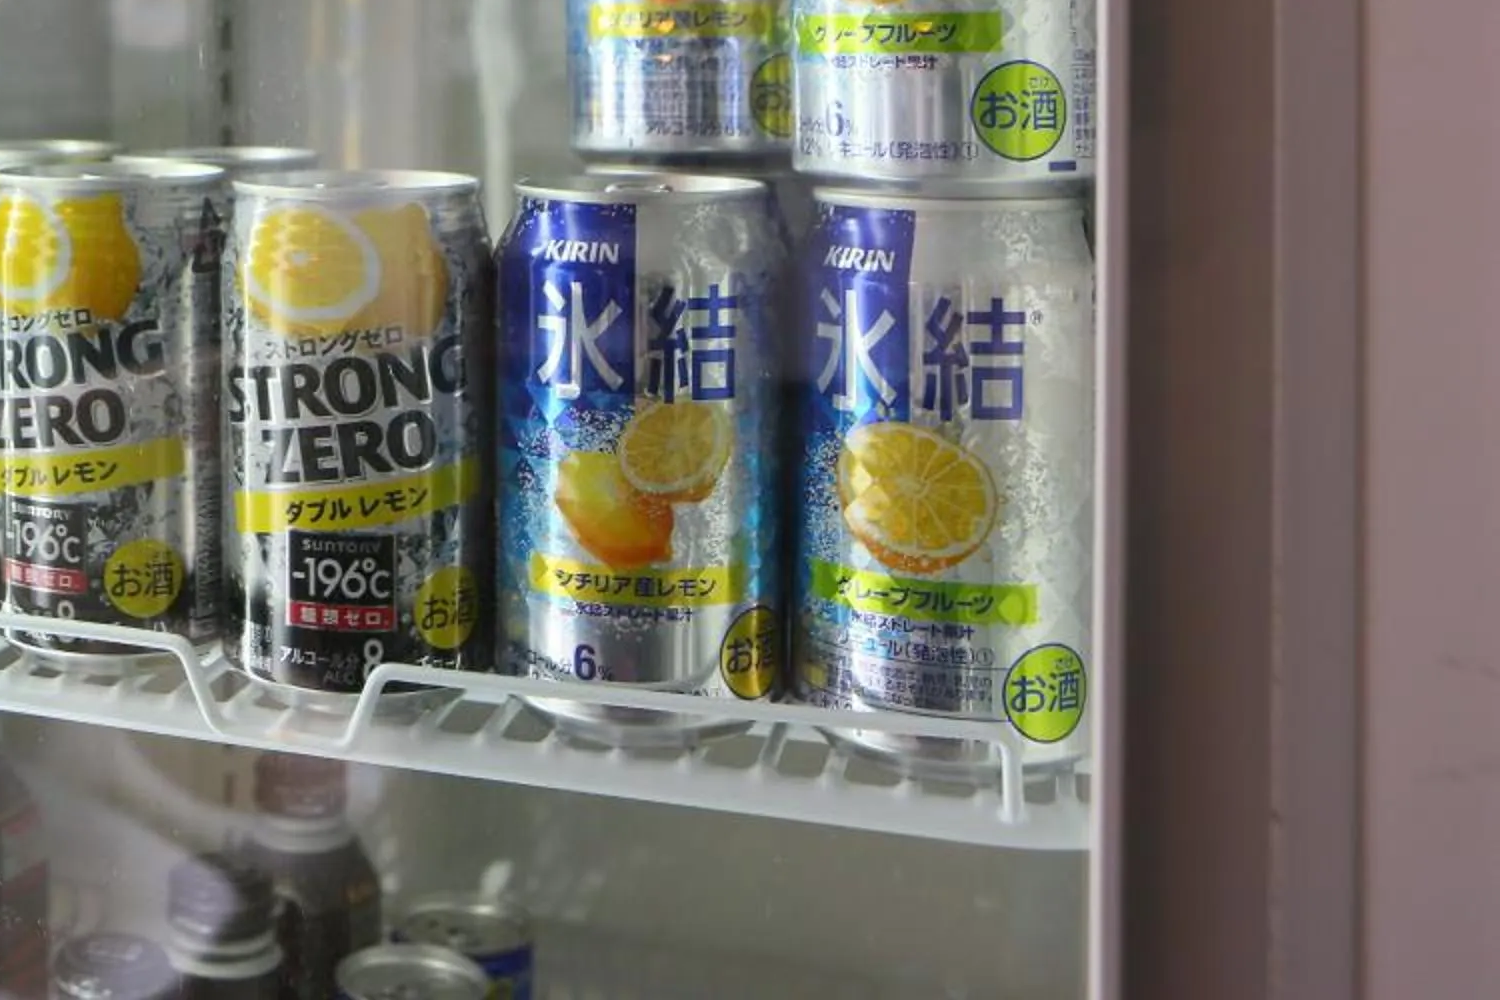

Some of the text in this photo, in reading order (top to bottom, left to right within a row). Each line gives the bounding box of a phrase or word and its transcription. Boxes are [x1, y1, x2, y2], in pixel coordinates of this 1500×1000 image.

[979, 88, 1059, 132] お酒
[542, 238, 621, 266] KIRIN
[822, 244, 896, 274] KIRIN
[264, 325, 404, 360] ストロングゼロ
[536, 278, 740, 406] 氷結
[815, 286, 1027, 424] 氷結
[227, 333, 468, 423] STRONG
[261, 409, 438, 484] ZERO
[301, 538, 384, 554] SUNTORY
[110, 560, 175, 598] お酒
[554, 568, 717, 598] シチリア産レモン
[836, 575, 995, 615] グレープフルーツ
[1009, 668, 1081, 714] お酒
